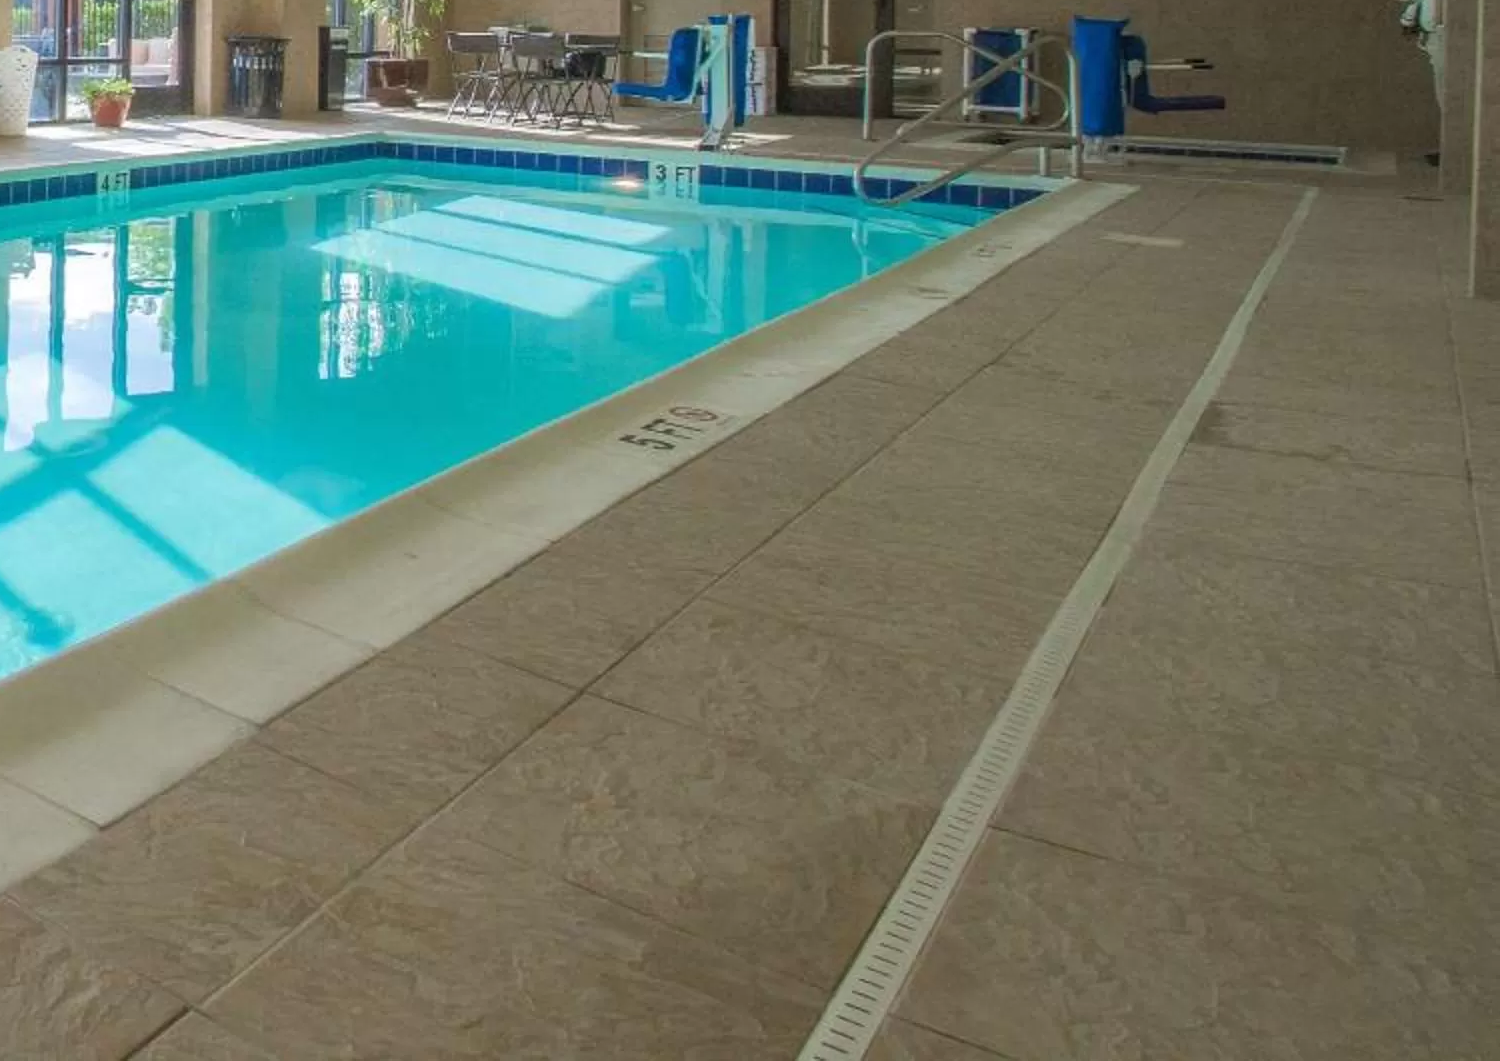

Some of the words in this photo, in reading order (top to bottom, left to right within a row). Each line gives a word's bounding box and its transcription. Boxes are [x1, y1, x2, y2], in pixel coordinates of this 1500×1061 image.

[101, 173, 109, 194] 4
[655, 164, 667, 182] 3
[675, 166, 696, 184] FT
[640, 418, 706, 440] FT
[618, 434, 676, 450] 5
